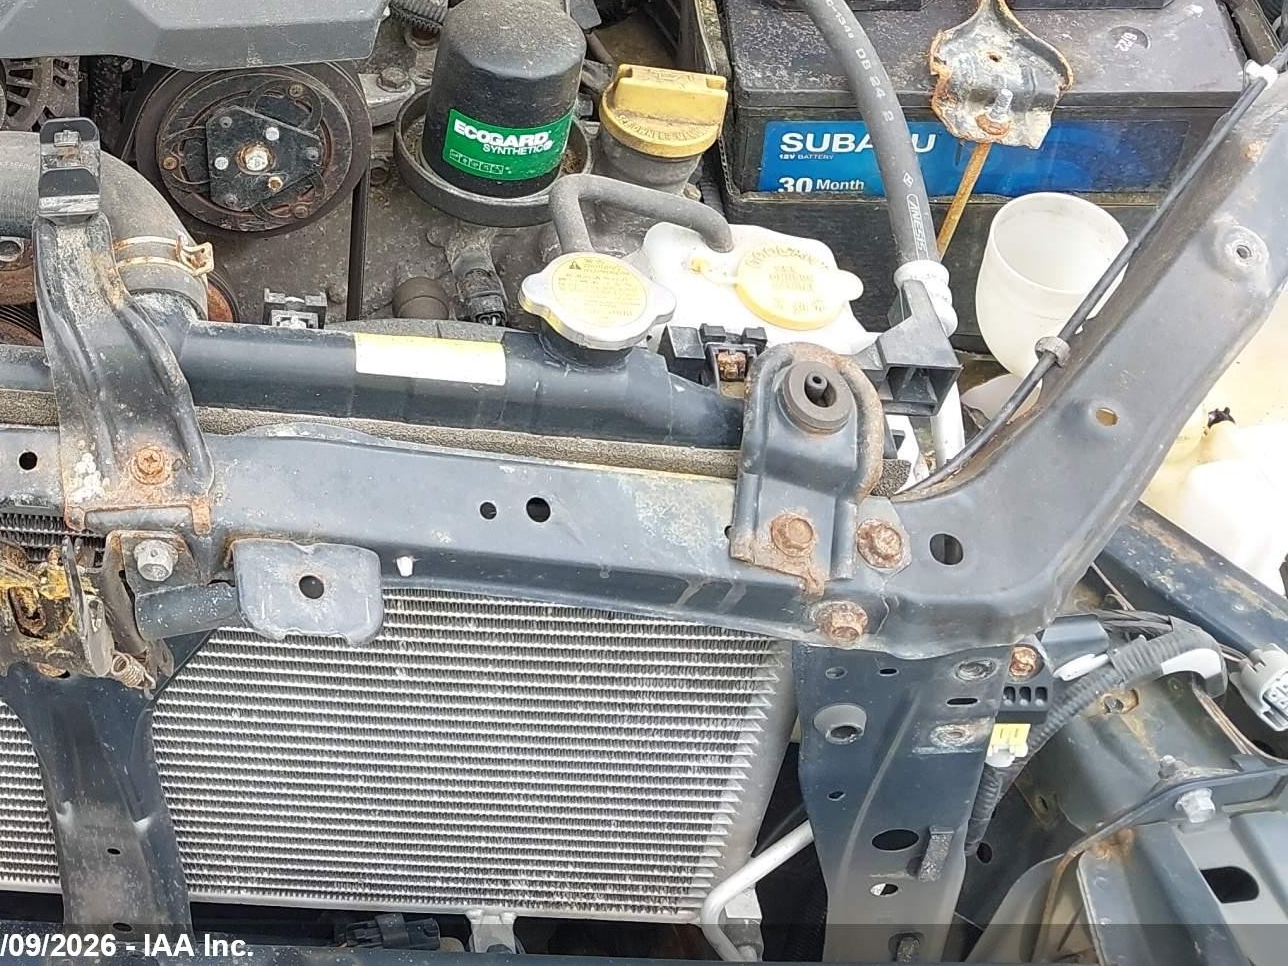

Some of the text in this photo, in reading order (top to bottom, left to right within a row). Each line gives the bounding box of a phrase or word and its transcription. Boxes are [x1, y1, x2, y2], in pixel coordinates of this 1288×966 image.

[855, 48, 872, 70] DB
[869, 76, 886, 99] 24
[454, 118, 549, 148] ECOGARD
[779, 132, 937, 153] SUBAU
[482, 143, 544, 155] SYNTHETIC
[777, 176, 865, 193] 30 Month
